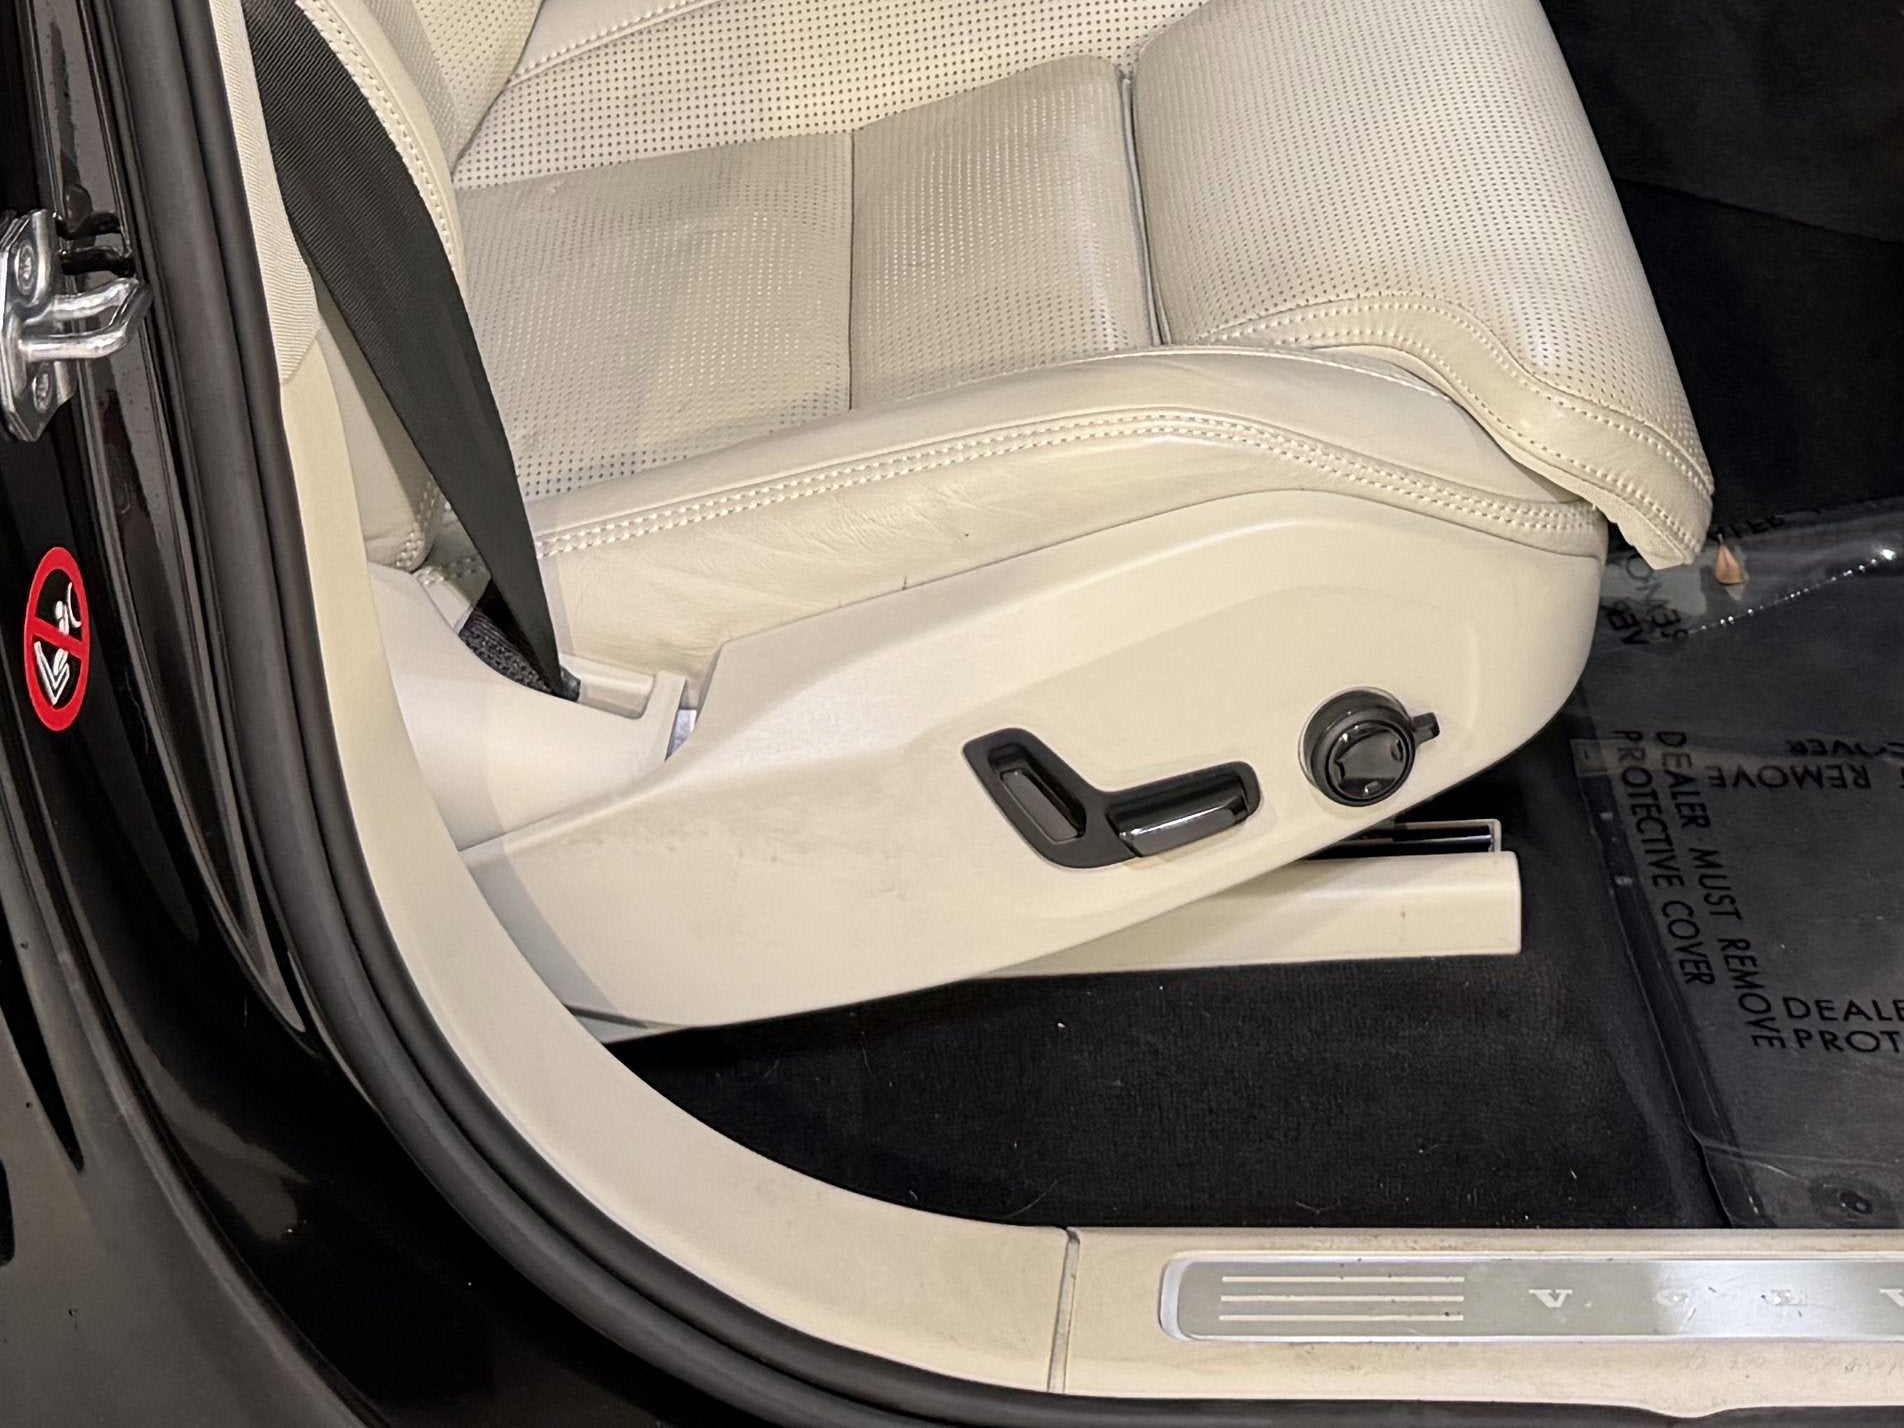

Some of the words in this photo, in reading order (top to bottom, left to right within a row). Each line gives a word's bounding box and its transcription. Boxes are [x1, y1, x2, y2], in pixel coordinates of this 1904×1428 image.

[1611, 728, 1685, 891] PROTECTIVE
[1661, 899, 1716, 986] COVER
[1654, 729, 1712, 830] DEALER
[1689, 846, 1743, 921] MUST
[1717, 937, 1787, 1049] REMOVE
[1705, 763, 1873, 790] REMOVE
